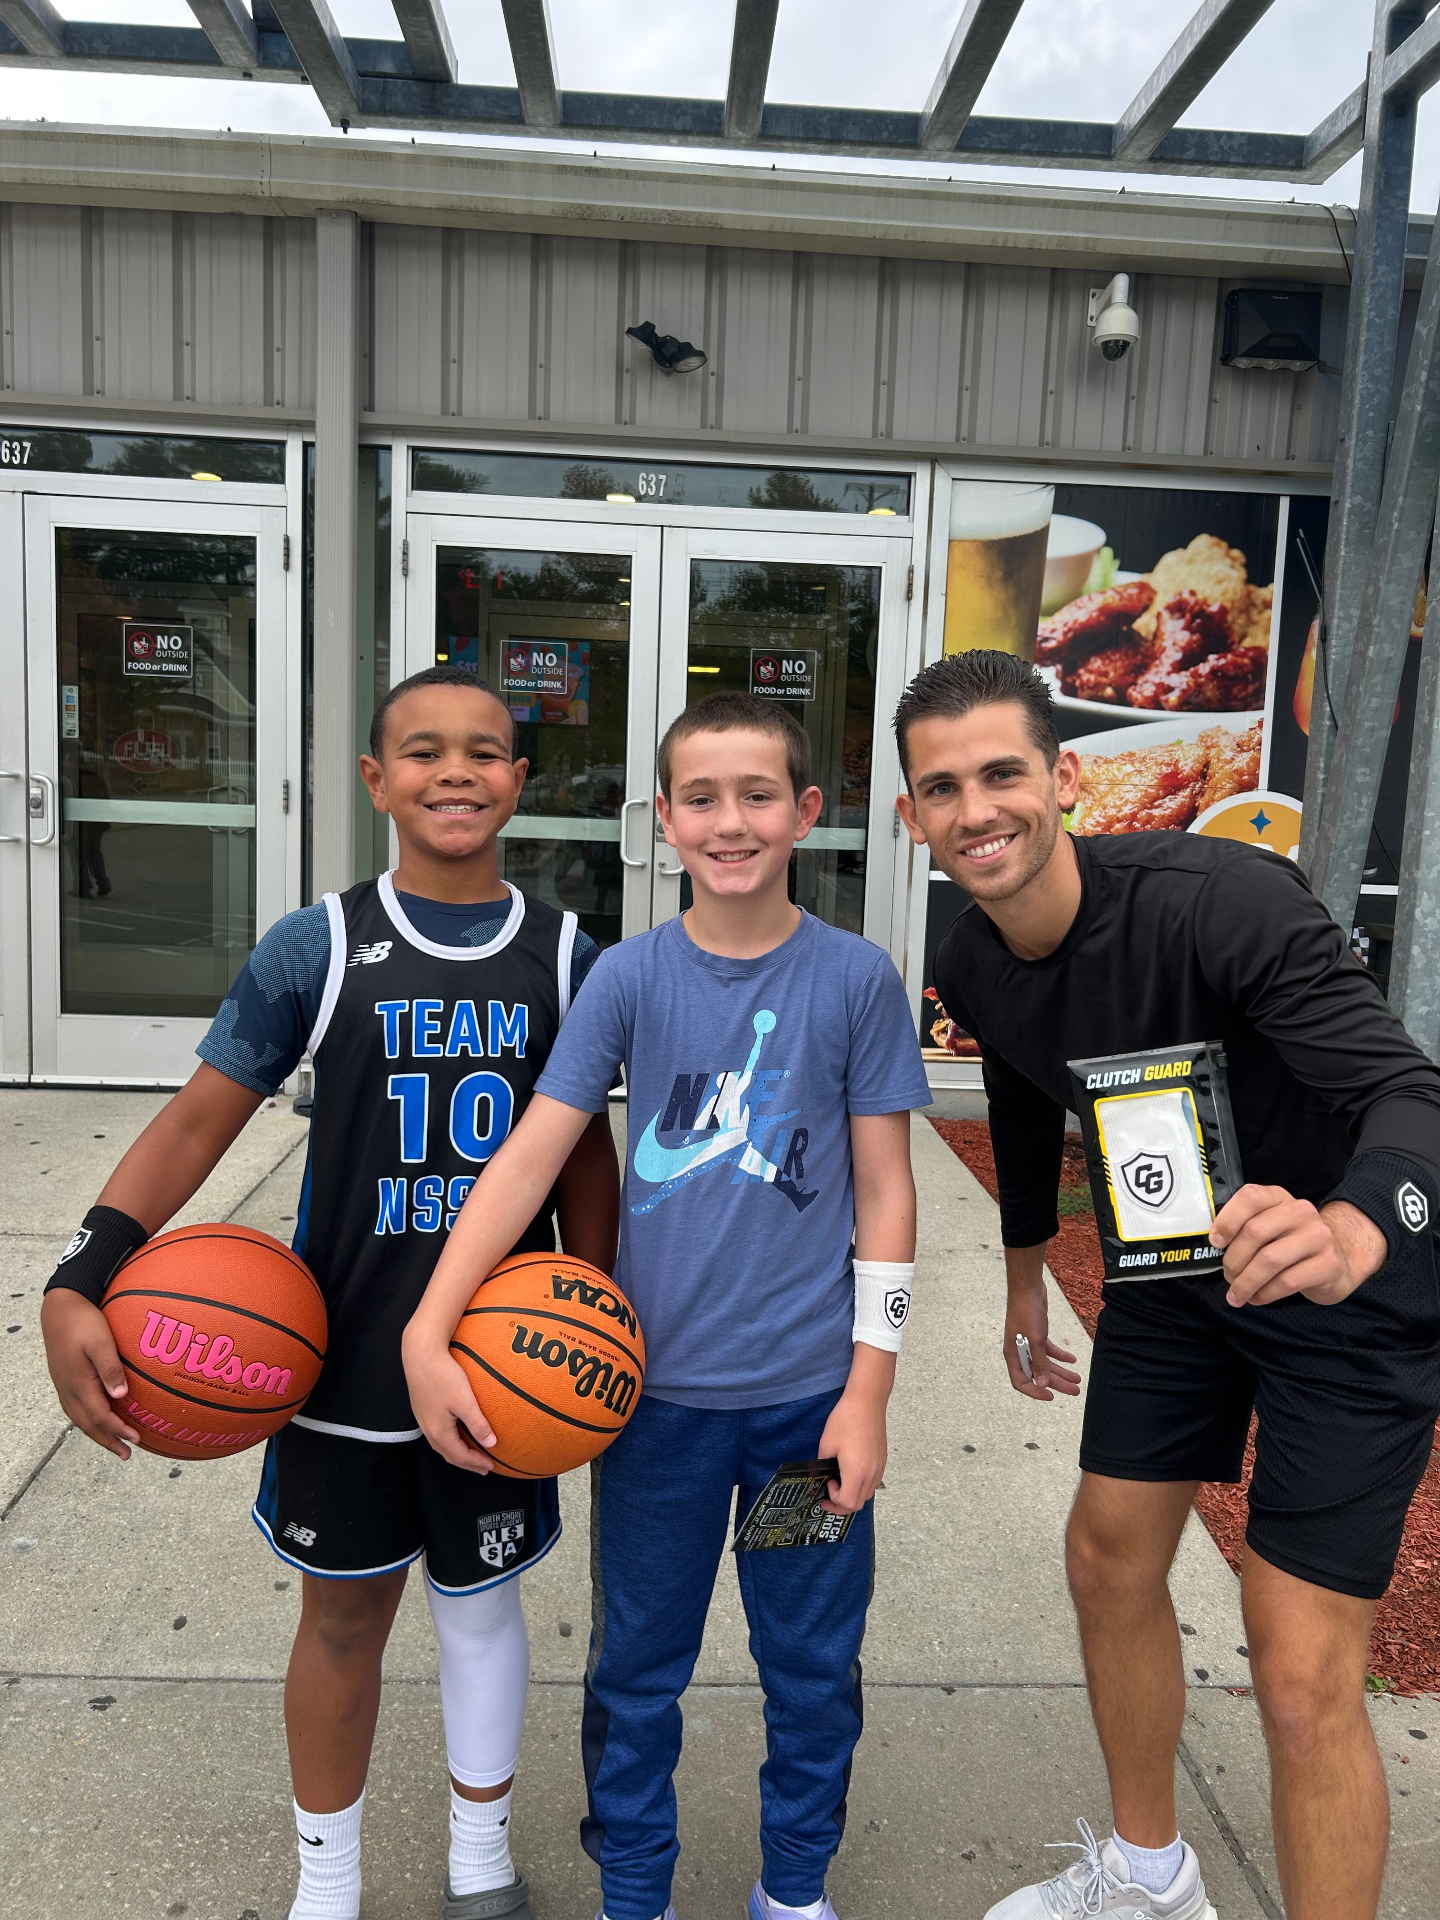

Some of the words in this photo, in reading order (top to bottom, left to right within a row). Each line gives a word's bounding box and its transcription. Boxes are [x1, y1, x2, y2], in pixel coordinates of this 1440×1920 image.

[2, 440, 32, 465] 637
[638, 472, 667, 497] 637
[156, 635, 182, 650] NO
[155, 650, 189, 659] OUTSIDE
[532, 652, 557, 667] NO
[127, 661, 152, 671] FOOD
[162, 663, 188, 672] DRINK
[531, 666, 564, 676] OUTSIDE
[782, 659, 807, 674] NO
[503, 678, 527, 687] FOOD
[537, 680, 562, 689] DRINK
[780, 674, 813, 682] OUTSIDE
[753, 686, 776, 695] FOOD
[786, 687, 811, 696] DRINK
[374, 999, 529, 1059] TEAM
[1086, 1068, 1141, 1090] CLUTCH
[1144, 1060, 1193, 1082] GUARD
[387, 1070, 515, 1164] 10
[1134, 1163, 1164, 1195] CG
[374, 1174, 479, 1236] NSS
[1118, 1252, 1158, 1268] GUARD
[1160, 1248, 1191, 1264] YOUR
[551, 1274, 638, 1340] NCAA
[889, 1296, 907, 1319] CG
[139, 1310, 293, 1396] Wilson
[510, 1323, 637, 1418] Wilson
[174, 1371, 206, 1386] INDOOR
[206, 1382, 230, 1392] GAME
[231, 1388, 250, 1397] BALL
[124, 1397, 263, 1446] VOLUTION
[479, 1514, 501, 1526] NORTH
[501, 1511, 522, 1521] SHORE
[479, 1522, 500, 1532] SPORTS
[500, 1518, 522, 1528] ACADEMY
[818, 1512, 836, 1539] RDS
[482, 1529, 497, 1546] N
[507, 1526, 518, 1540] S
[487, 1546, 499, 1561] S
[503, 1541, 517, 1557] A
